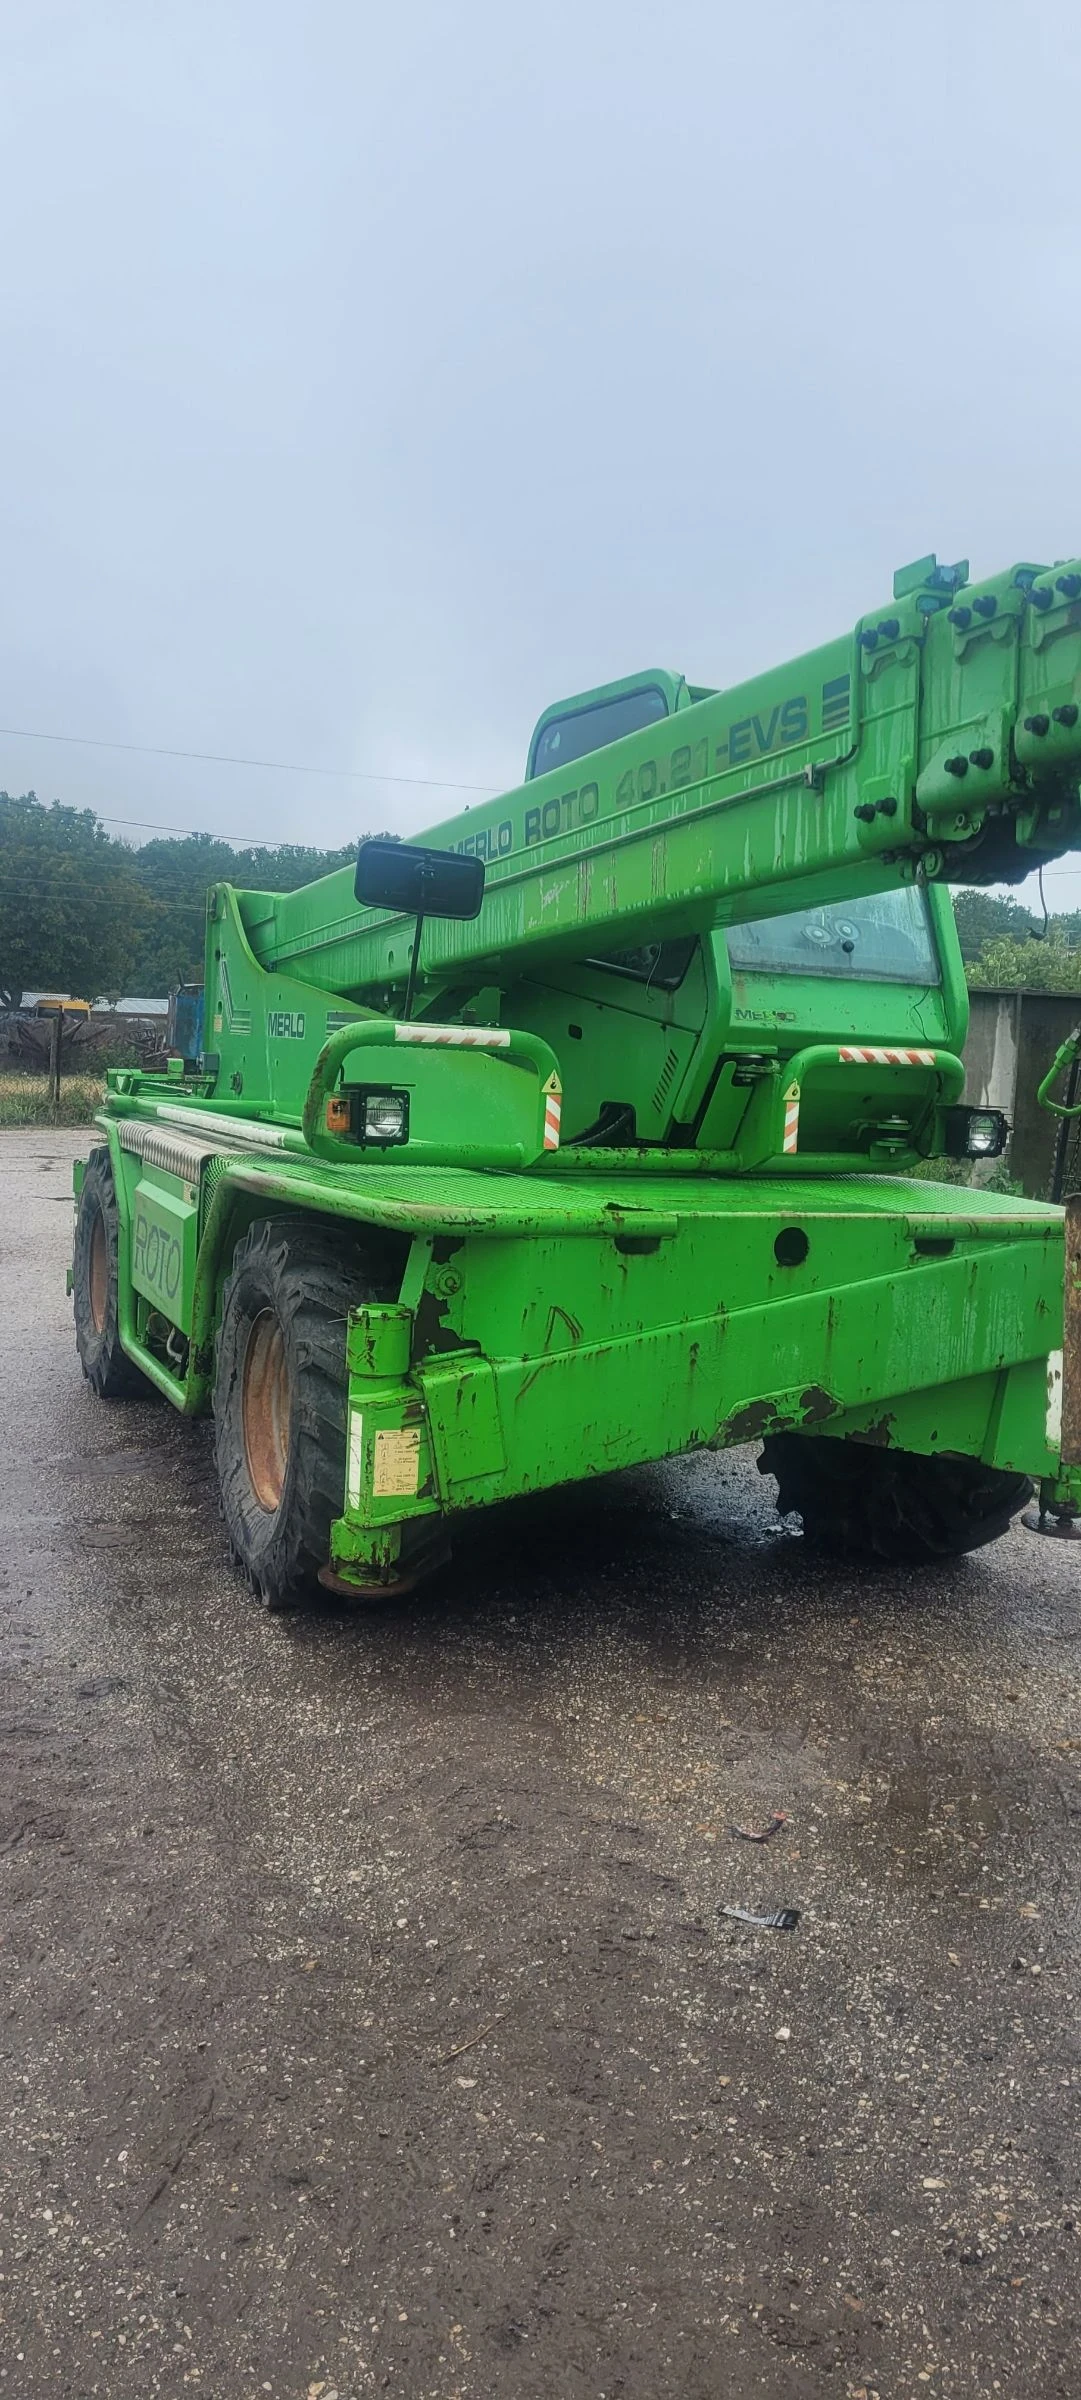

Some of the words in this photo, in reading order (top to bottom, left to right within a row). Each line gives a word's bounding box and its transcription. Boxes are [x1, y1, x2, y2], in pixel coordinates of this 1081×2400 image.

[525, 781, 599, 848] ROTO
[268, 1012, 305, 1039] MERLO
[134, 1213, 180, 1299] ROTO
